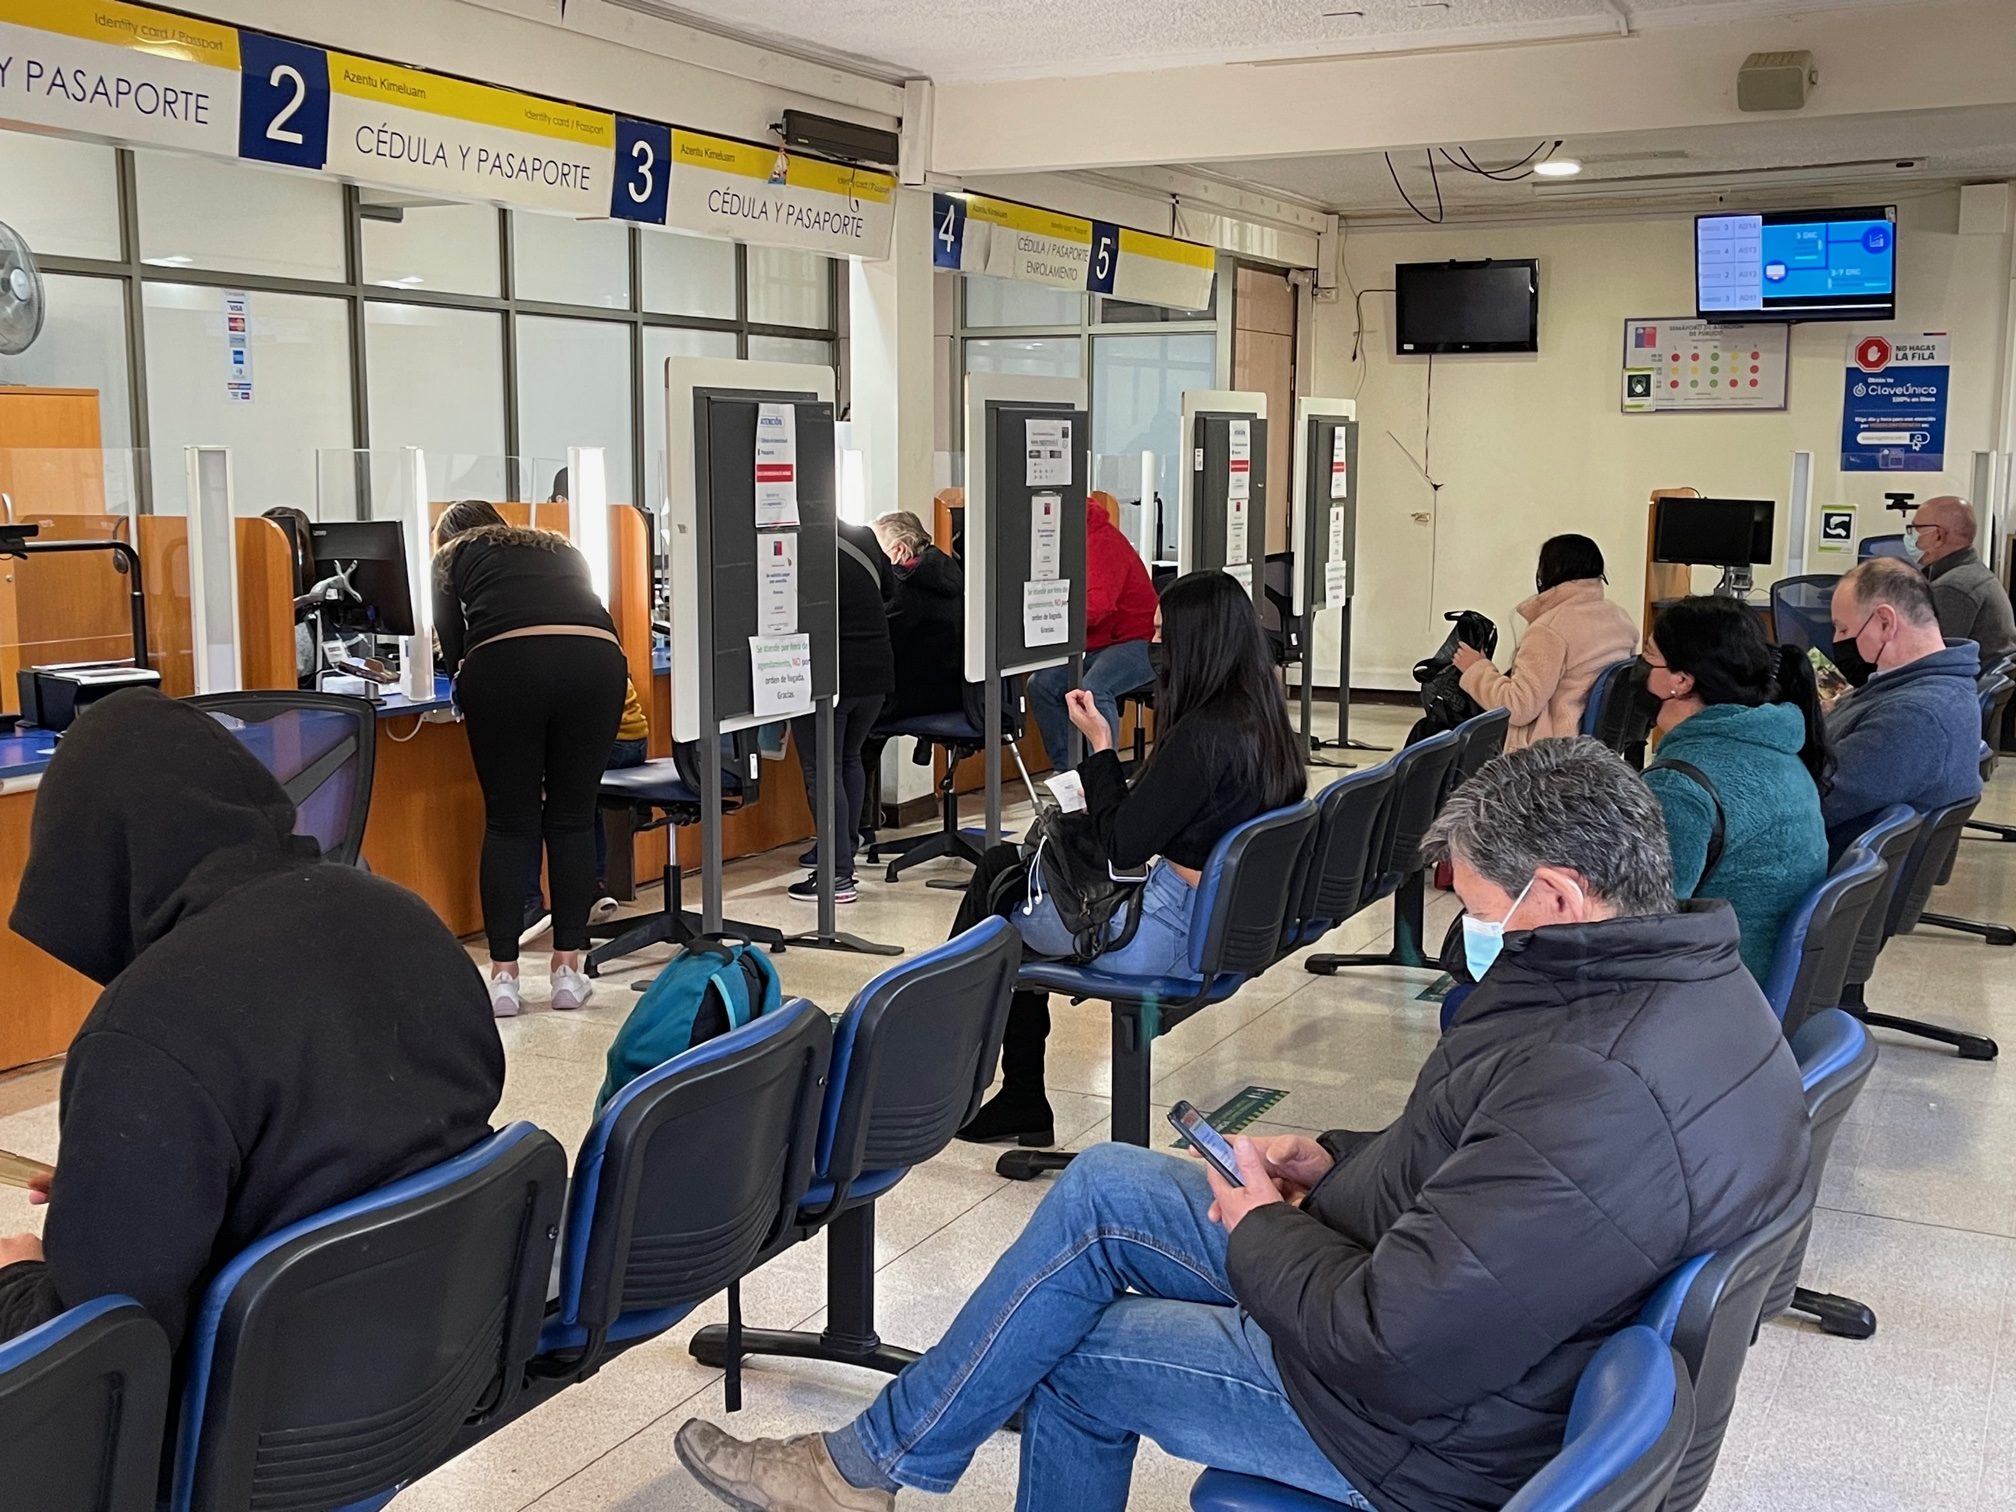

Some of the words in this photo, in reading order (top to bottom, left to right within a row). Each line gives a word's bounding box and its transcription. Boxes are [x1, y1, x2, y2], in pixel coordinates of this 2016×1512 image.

[95, 13, 138, 33] Identity
[141, 24, 168, 39] card
[178, 31, 223, 51] Passport
[0, 56, 13, 88] Y
[27, 60, 209, 125] PASAPORTE
[343, 69, 378, 88] Azentu
[380, 73, 427, 99] Kimeluam
[266, 64, 306, 145] 2
[525, 109, 551, 126] Identity
[553, 115, 570, 128] card
[576, 120, 604, 136] Passport
[356, 122, 448, 168] CÉDULA
[458, 144, 471, 171] Y
[477, 148, 591, 190] PASAPORTE
[628, 140, 654, 203] 3
[708, 186, 768, 221] CÉDULA
[774, 202, 783, 224] Y
[785, 204, 864, 239] PASAPORTE
[938, 204, 955, 253] 4
[1018, 236, 1046, 256] CÉDULA
[1052, 243, 1089, 263] PASAPORTE
[1096, 237, 1112, 280] 5
[1026, 260, 1078, 281] ENROLAMIENTO
[1895, 352, 1909, 361] LA
[1911, 352, 1935, 361] FILA
[1868, 383, 1937, 395] ClaveÚnica
[756, 645, 763, 653] Se
[792, 657, 801, 666] NO
[765, 676, 780, 685] orden
[781, 674, 787, 683] de
